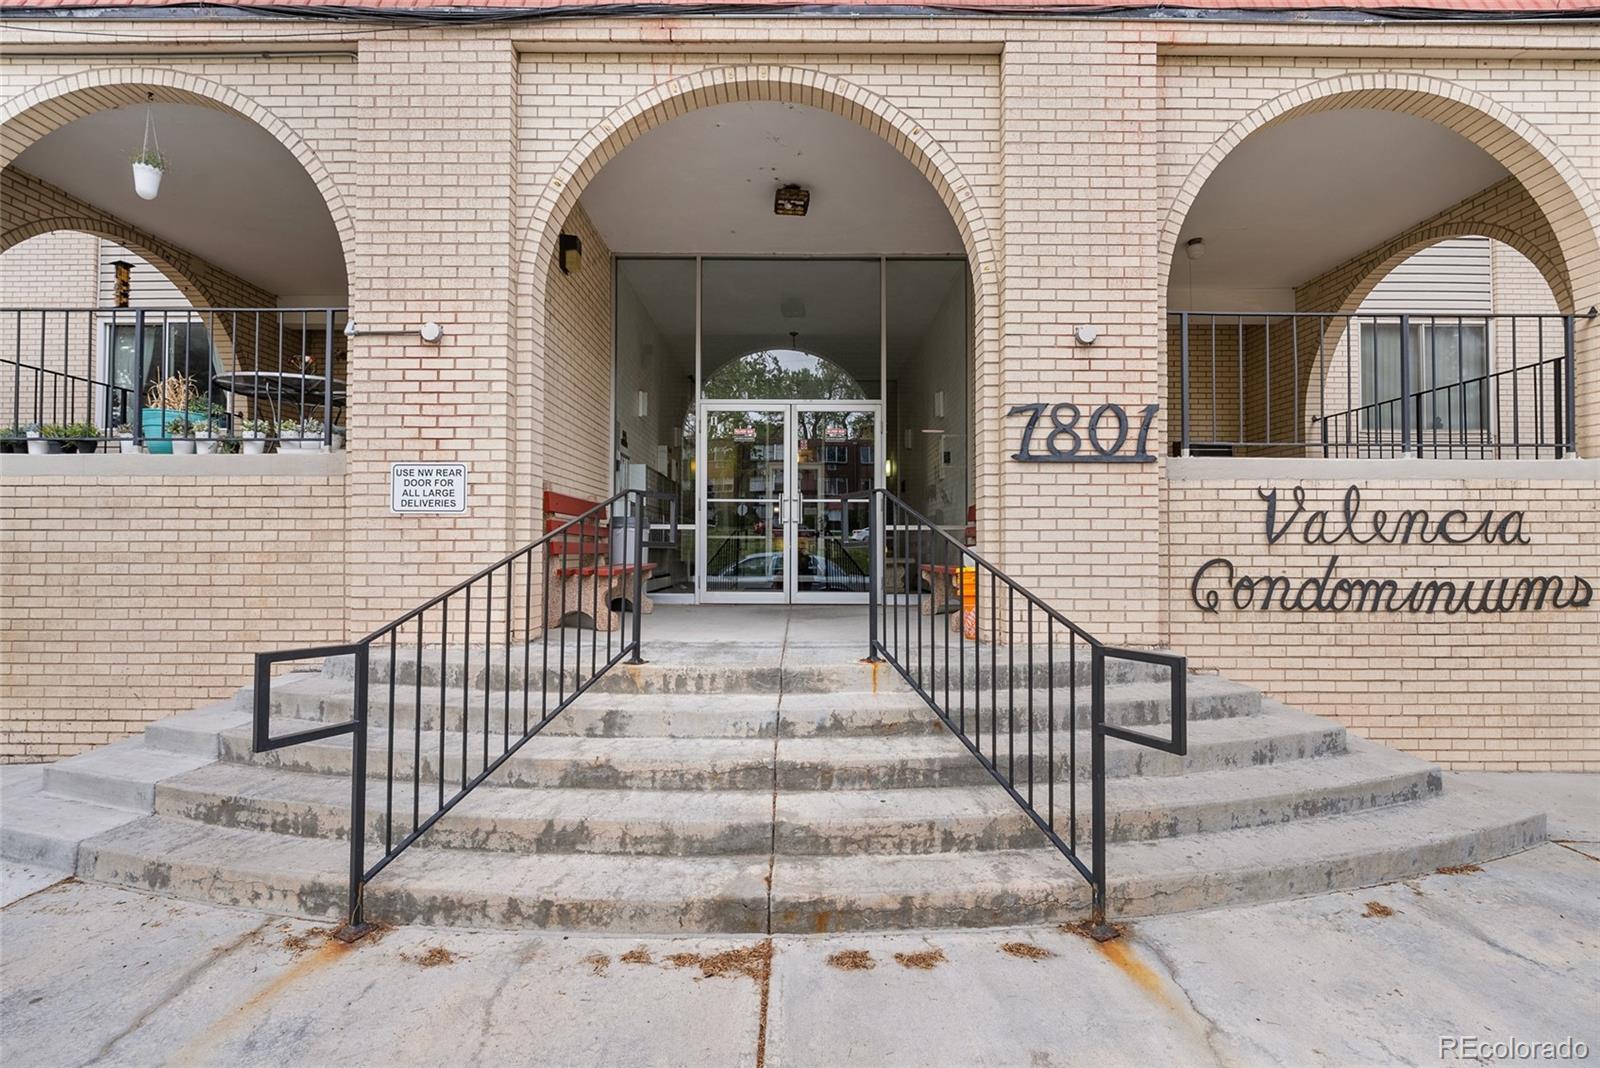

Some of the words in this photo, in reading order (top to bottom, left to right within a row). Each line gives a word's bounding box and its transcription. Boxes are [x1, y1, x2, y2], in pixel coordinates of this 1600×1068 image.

[1007, 402, 1160, 463] 7801
[395, 468, 415, 477] USE
[417, 468, 434, 477] NW
[435, 468, 462, 477] REAR
[403, 479, 432, 487] DOOR
[434, 479, 454, 487] FOR
[402, 489, 420, 497] ALL
[422, 489, 455, 497] LARGE
[400, 499, 457, 508] DELIVERIES
[1257, 484, 1531, 546] Valencia
[1190, 555, 1594, 615] Condominiums
